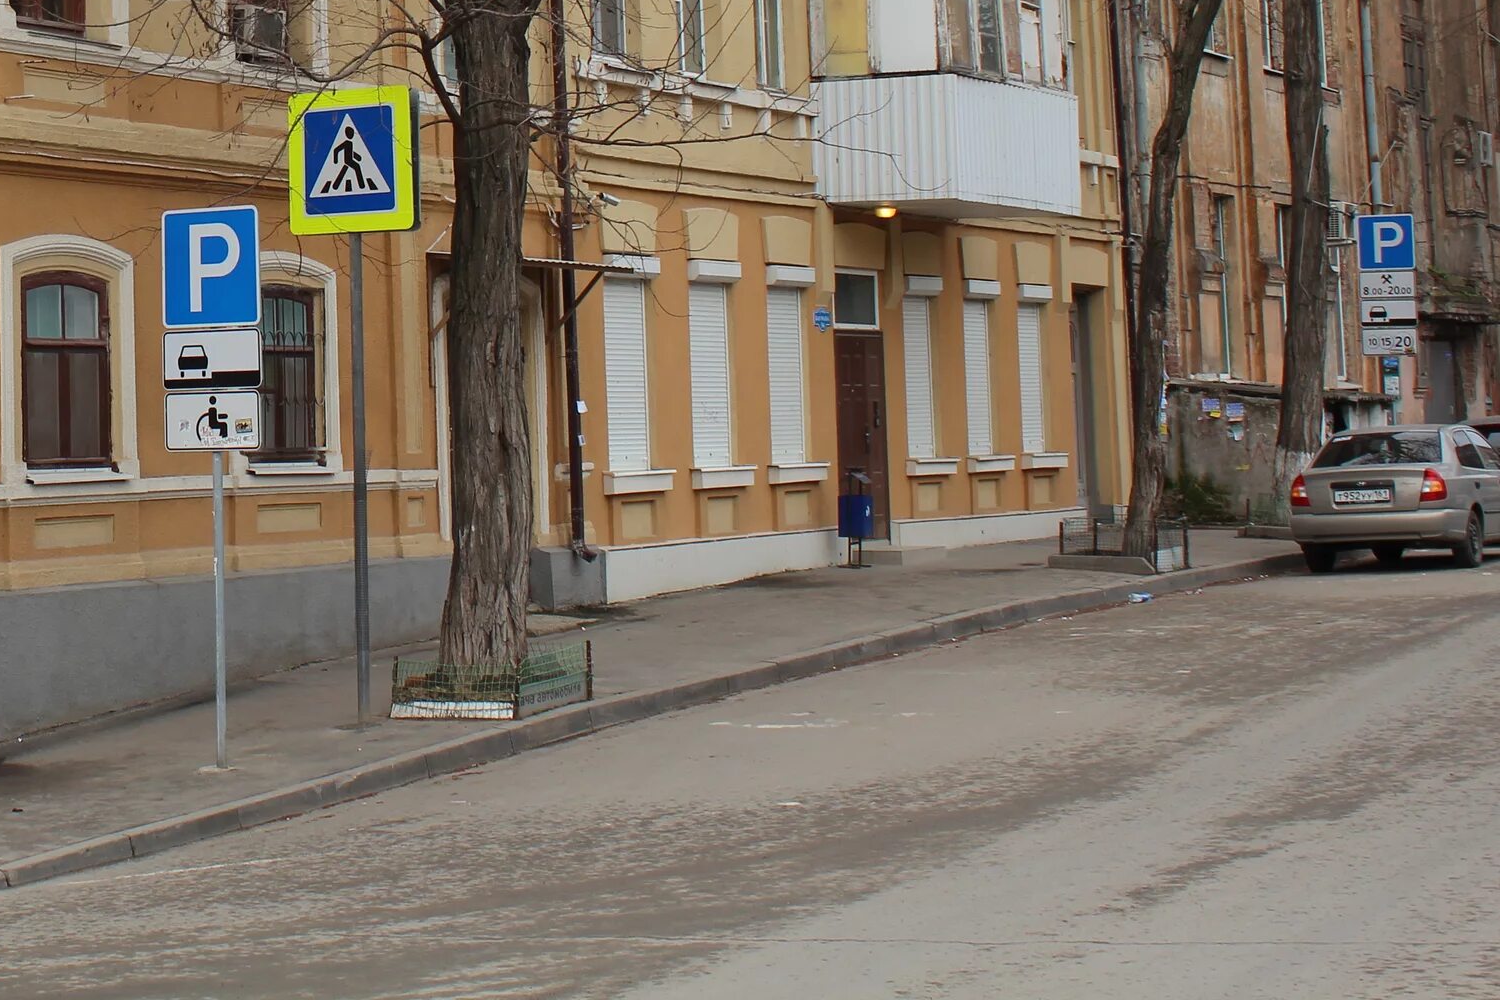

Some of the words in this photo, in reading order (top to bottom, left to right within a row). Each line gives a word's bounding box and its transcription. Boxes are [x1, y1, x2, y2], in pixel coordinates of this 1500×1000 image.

[1373, 222, 1403, 264] P
[189, 222, 241, 313] P
[1368, 338, 1378, 346] 10
[1380, 337, 1392, 346] 15
[1395, 336, 1412, 347] 20
